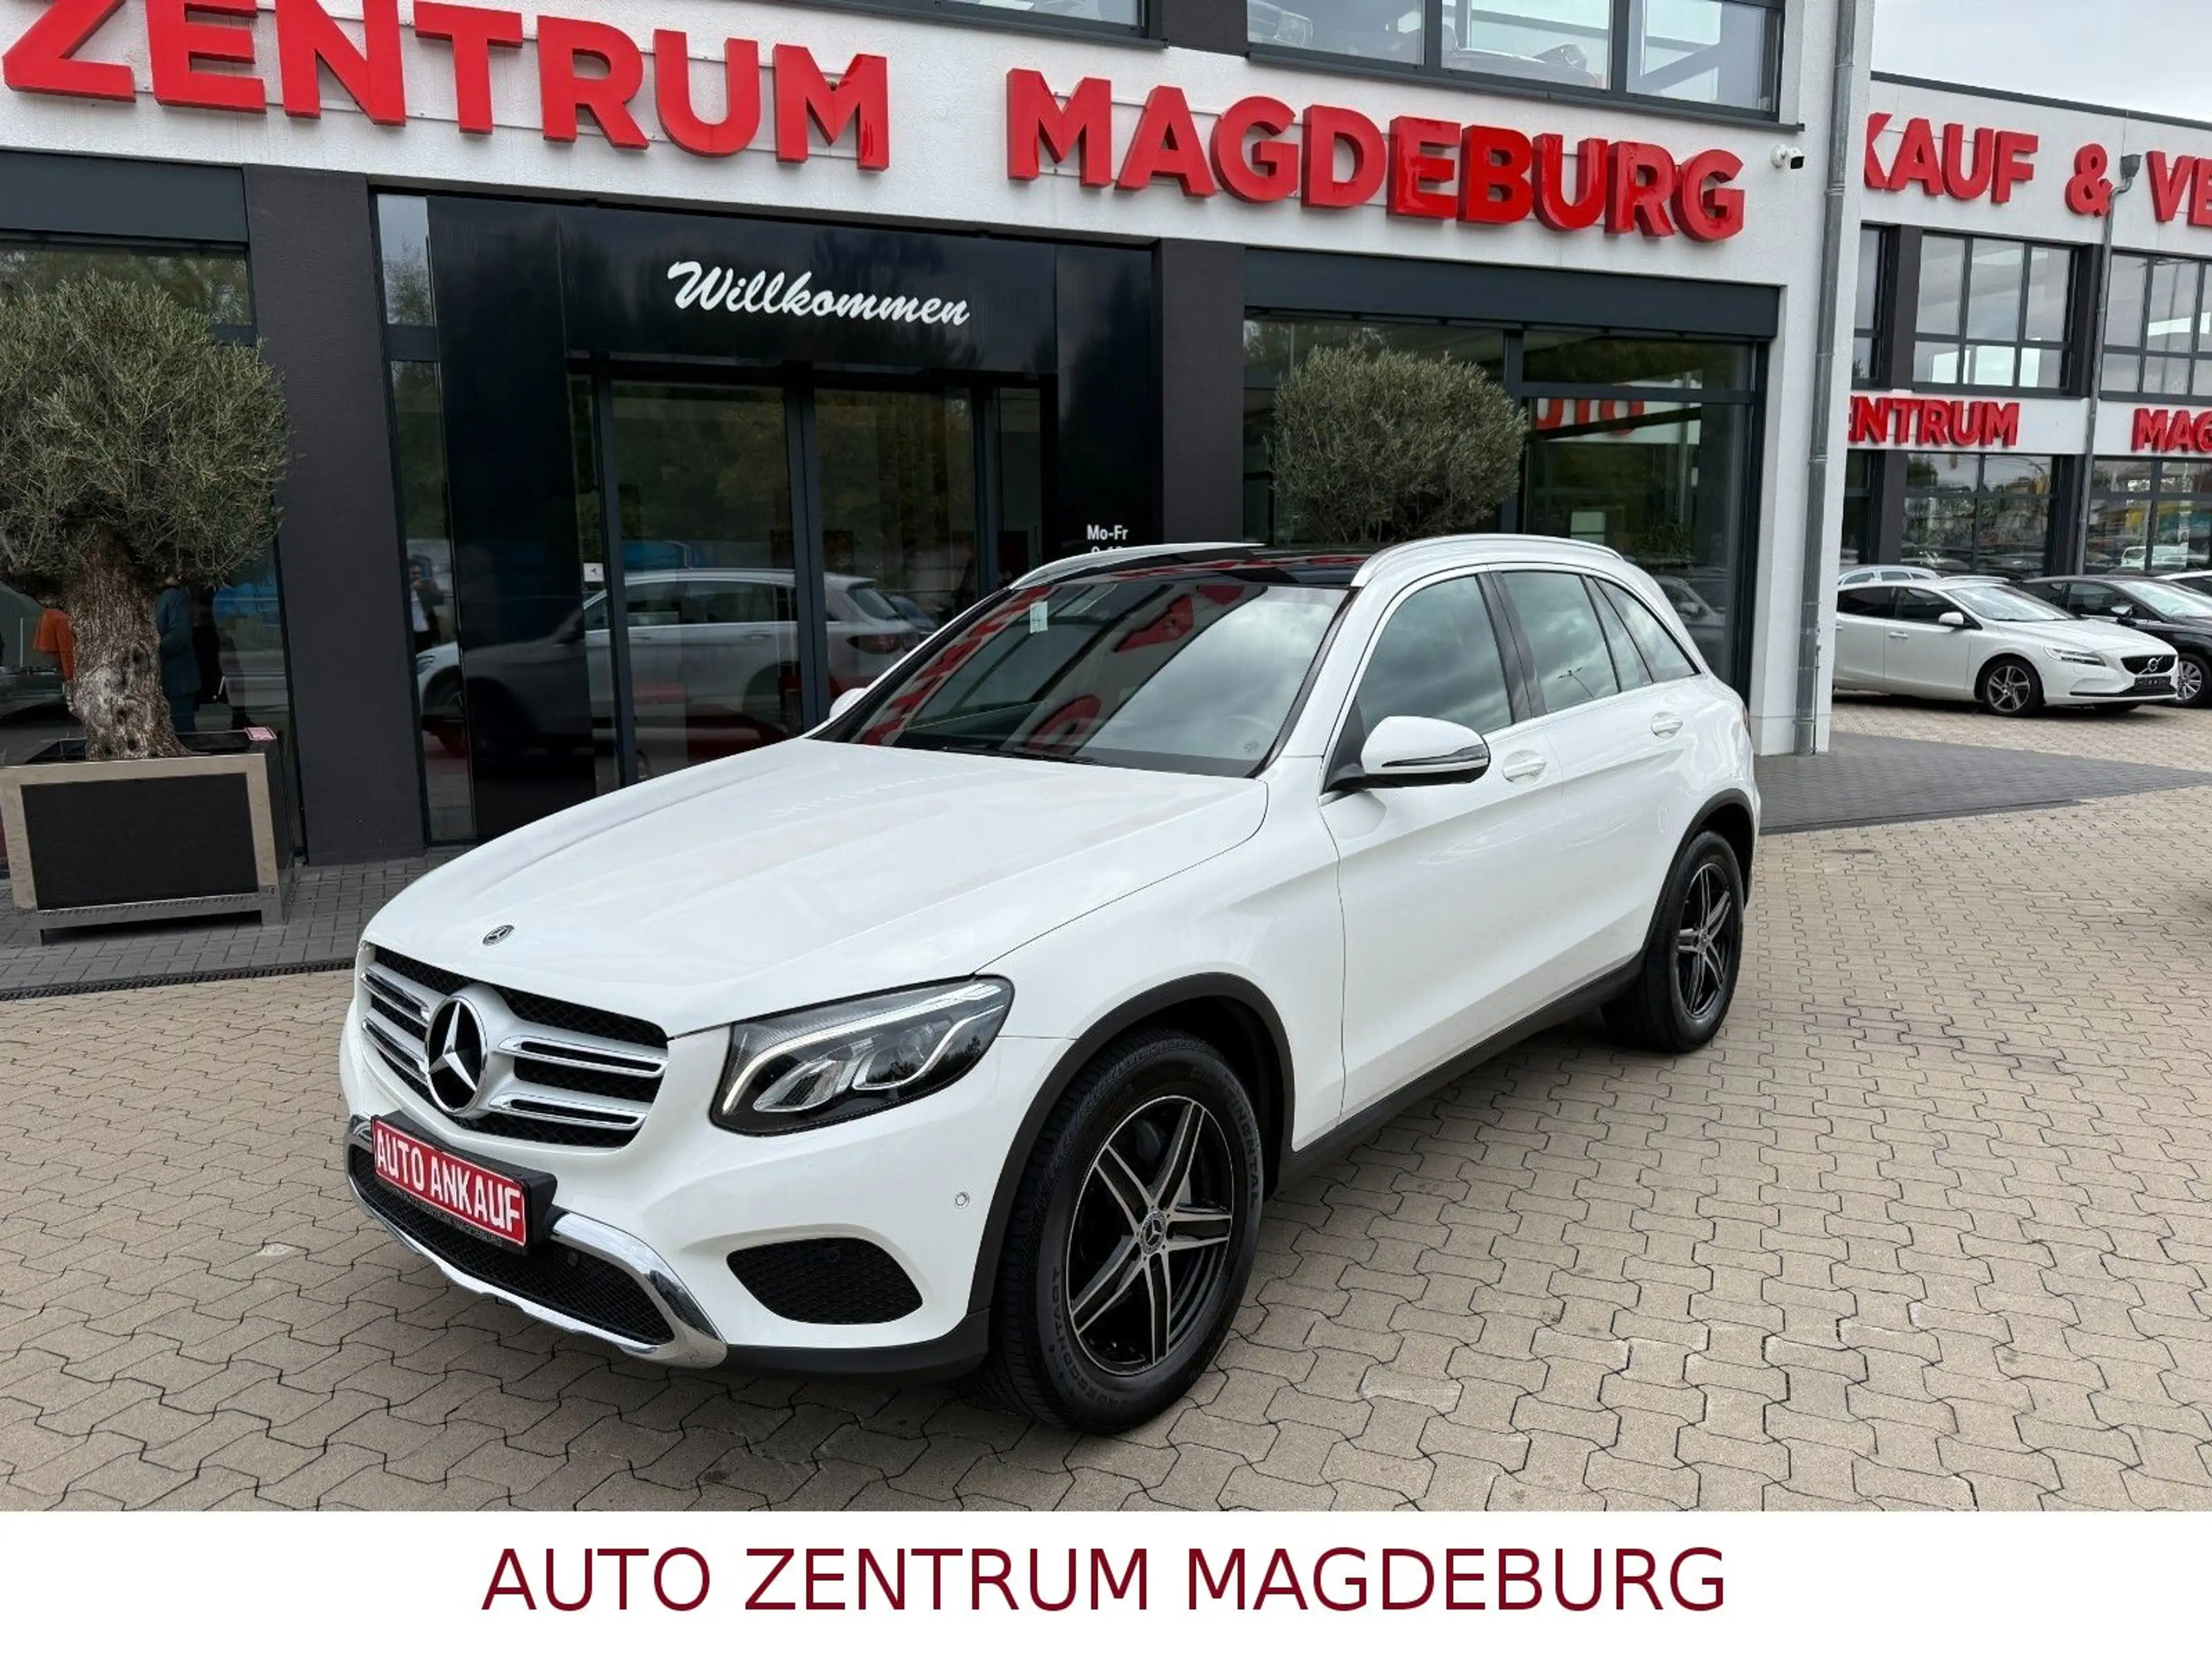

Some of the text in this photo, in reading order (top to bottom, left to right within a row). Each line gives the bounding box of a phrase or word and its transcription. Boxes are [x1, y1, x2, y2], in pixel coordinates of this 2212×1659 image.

[1, 0, 1745, 242] ZENTRUM MAGDEBURG
[2065, 143, 2113, 217] &
[667, 261, 970, 327] Willkommen
[1848, 395, 2212, 452] NTRUM MAG
[1087, 524, 1129, 540] Mo-Fr
[377, 1129, 521, 1233] AUTO ANKAUF
